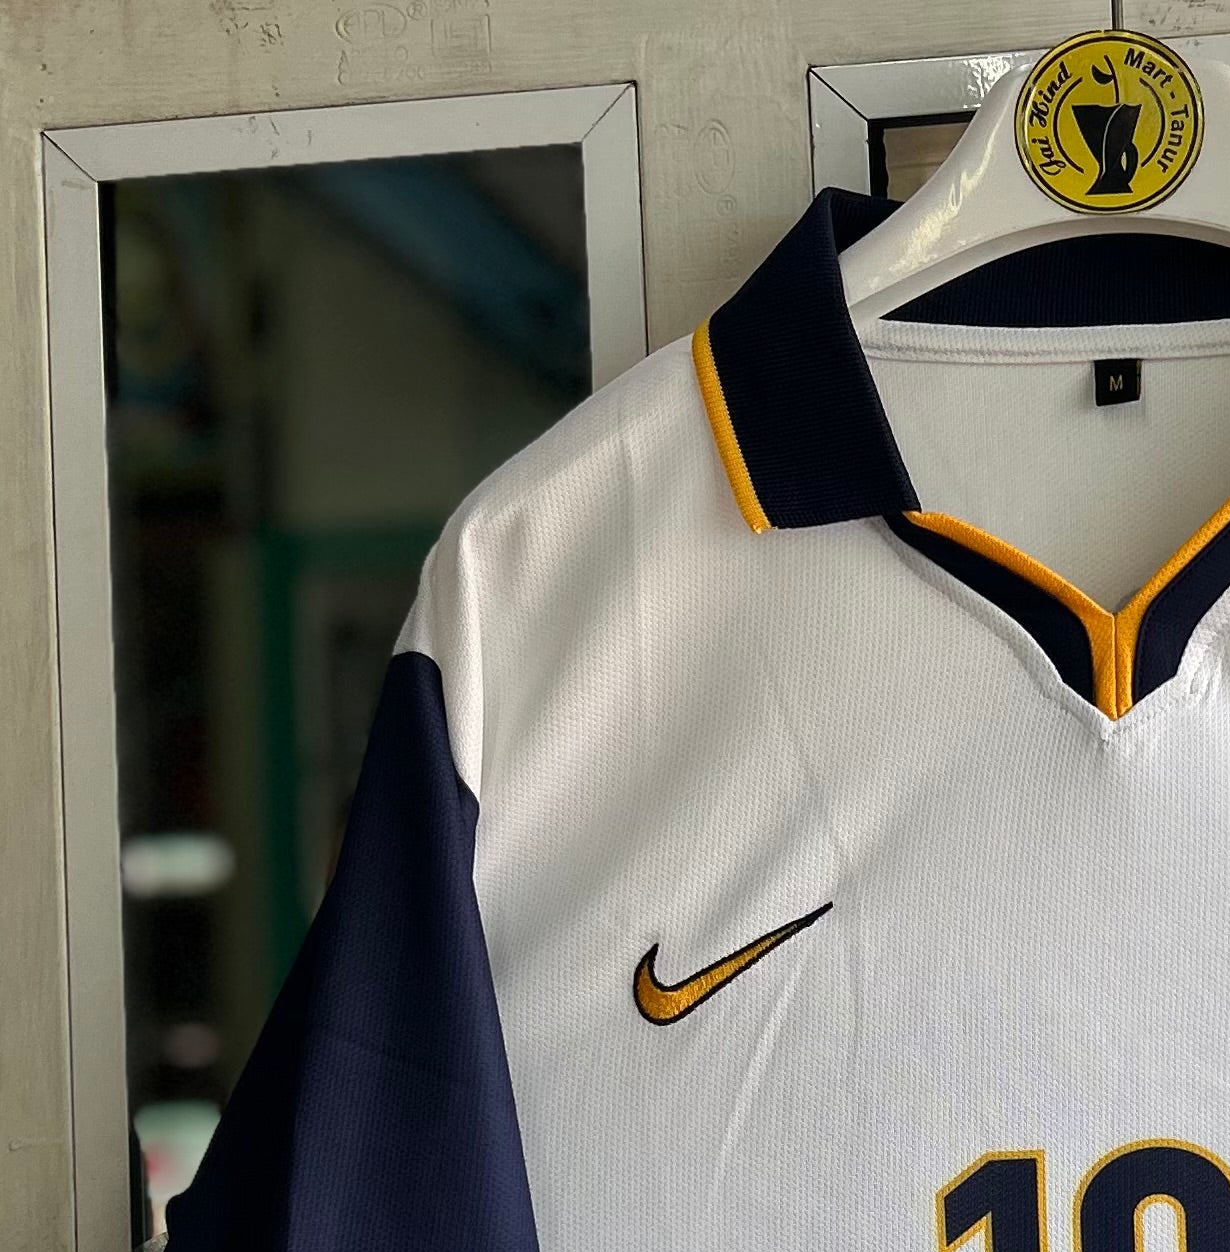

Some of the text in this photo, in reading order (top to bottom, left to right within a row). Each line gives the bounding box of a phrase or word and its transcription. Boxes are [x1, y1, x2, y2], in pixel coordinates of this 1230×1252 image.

[1123, 48, 1174, 89] Mart
[1029, 61, 1073, 127] Hind
[1032, 136, 1066, 176] Jai
[1156, 104, 1190, 174] Tanur
[1109, 374, 1123, 391] M
